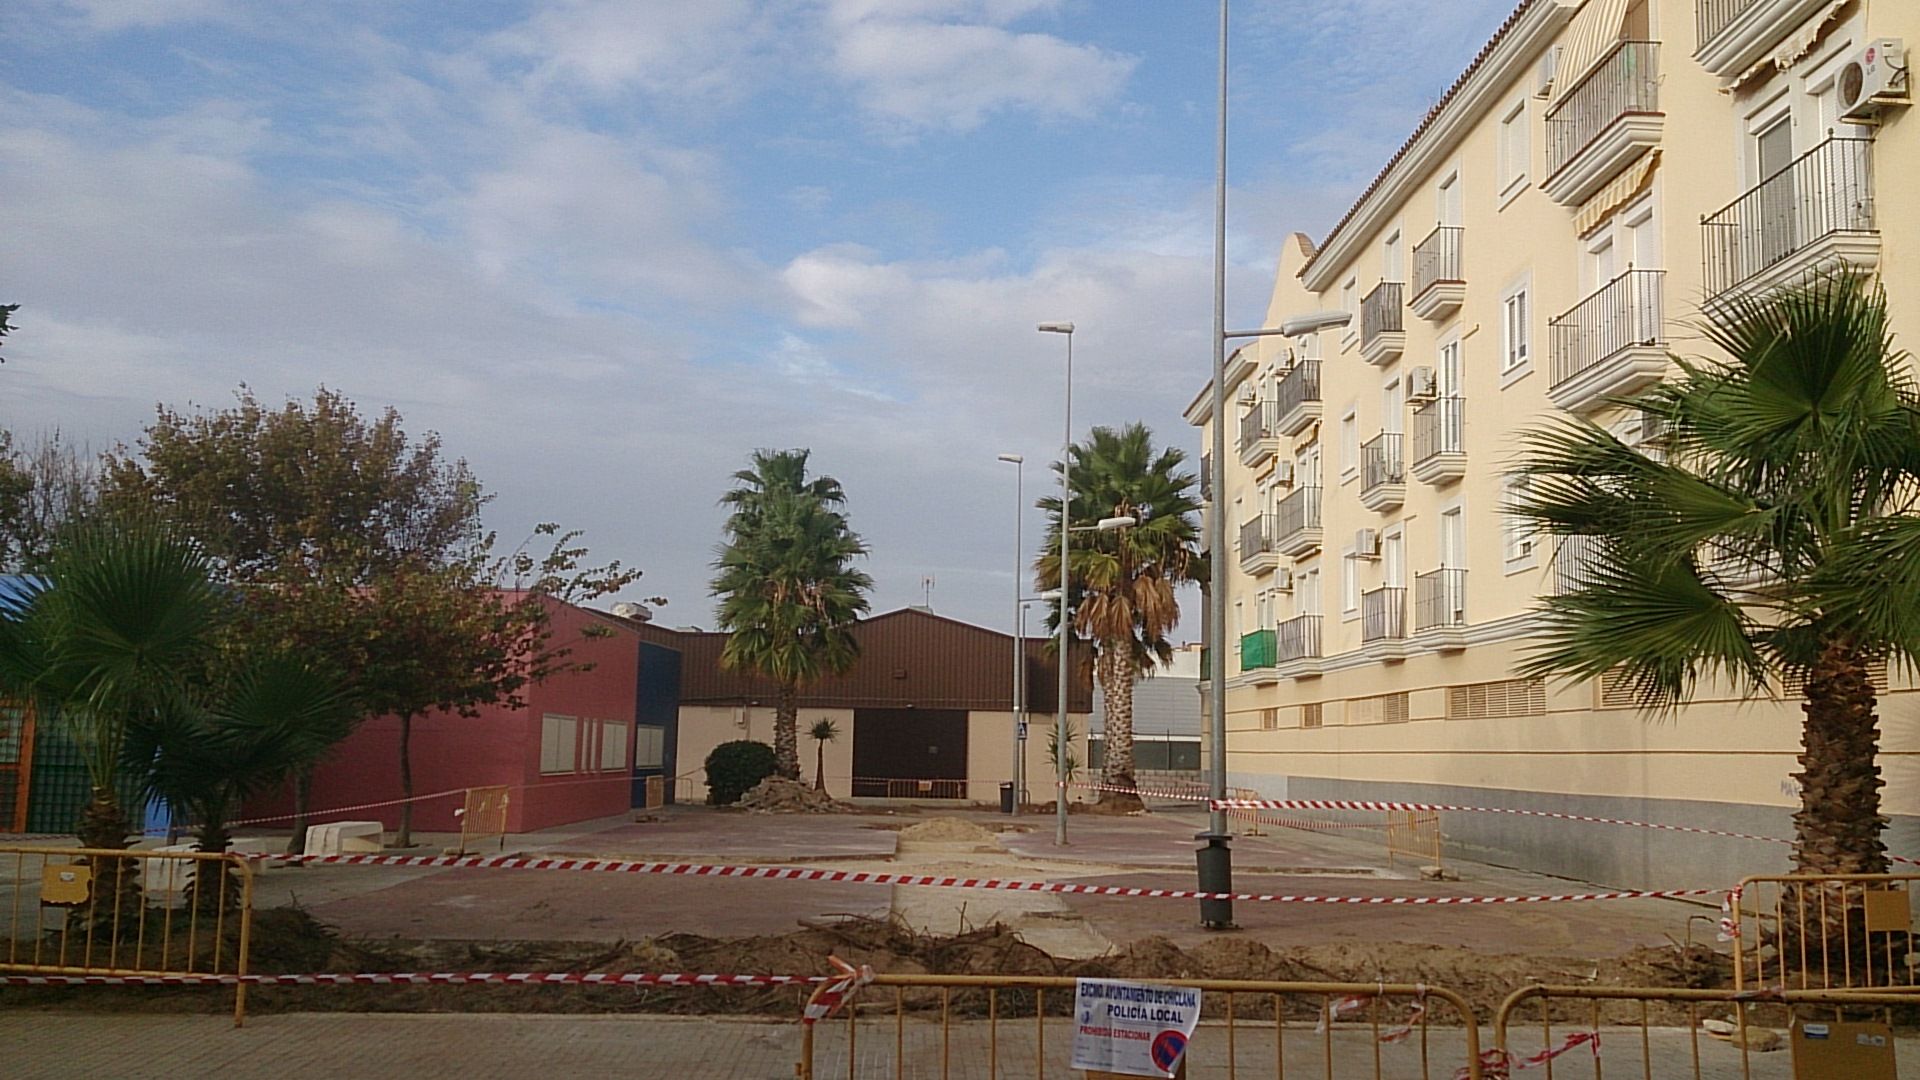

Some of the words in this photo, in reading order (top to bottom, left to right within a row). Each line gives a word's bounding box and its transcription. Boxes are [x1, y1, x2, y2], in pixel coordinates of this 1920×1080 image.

[1105, 984, 1153, 1003] AYUNTAMIENTO
[1154, 990, 1163, 1005] DE
[1164, 991, 1196, 1008] CHICLANA
[1107, 1004, 1148, 1020] POLICÍA
[1150, 1008, 1184, 1024] LOCAL
[1080, 1025, 1112, 1037] PROHIBIDO
[1113, 1028, 1151, 1041] ESTACIONAR
